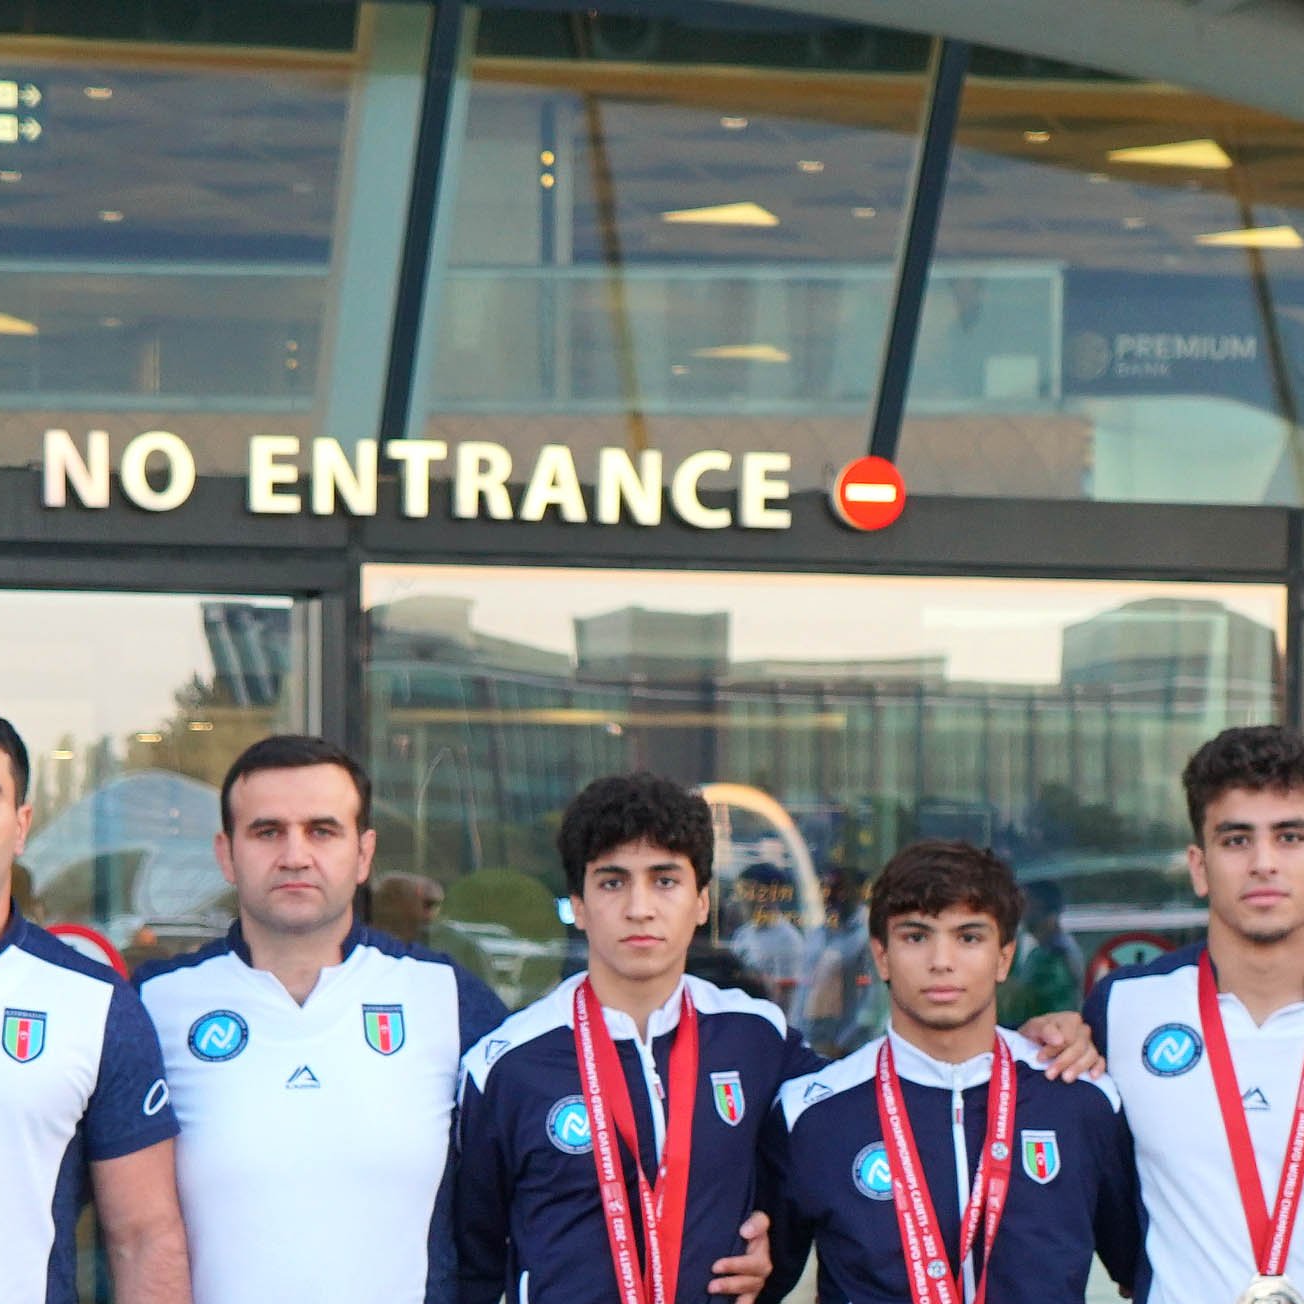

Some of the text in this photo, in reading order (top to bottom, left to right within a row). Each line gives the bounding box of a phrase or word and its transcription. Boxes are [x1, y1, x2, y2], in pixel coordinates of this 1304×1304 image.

[1116, 333, 1257, 360] PREMIUM
[43, 430, 196, 513] NO
[248, 434, 793, 529] ENTRANCE
[578, 1020, 600, 1095] CHAMPIONSHIPS
[590, 1094, 606, 1130] WORLD
[887, 1113, 919, 1191] CHAMPIONSHIPS
[908, 1188, 930, 1228] CADETS
[920, 1233, 939, 1259] 2022
[616, 1249, 634, 1288] CADETS
[911, 1259, 929, 1295] WORLD
